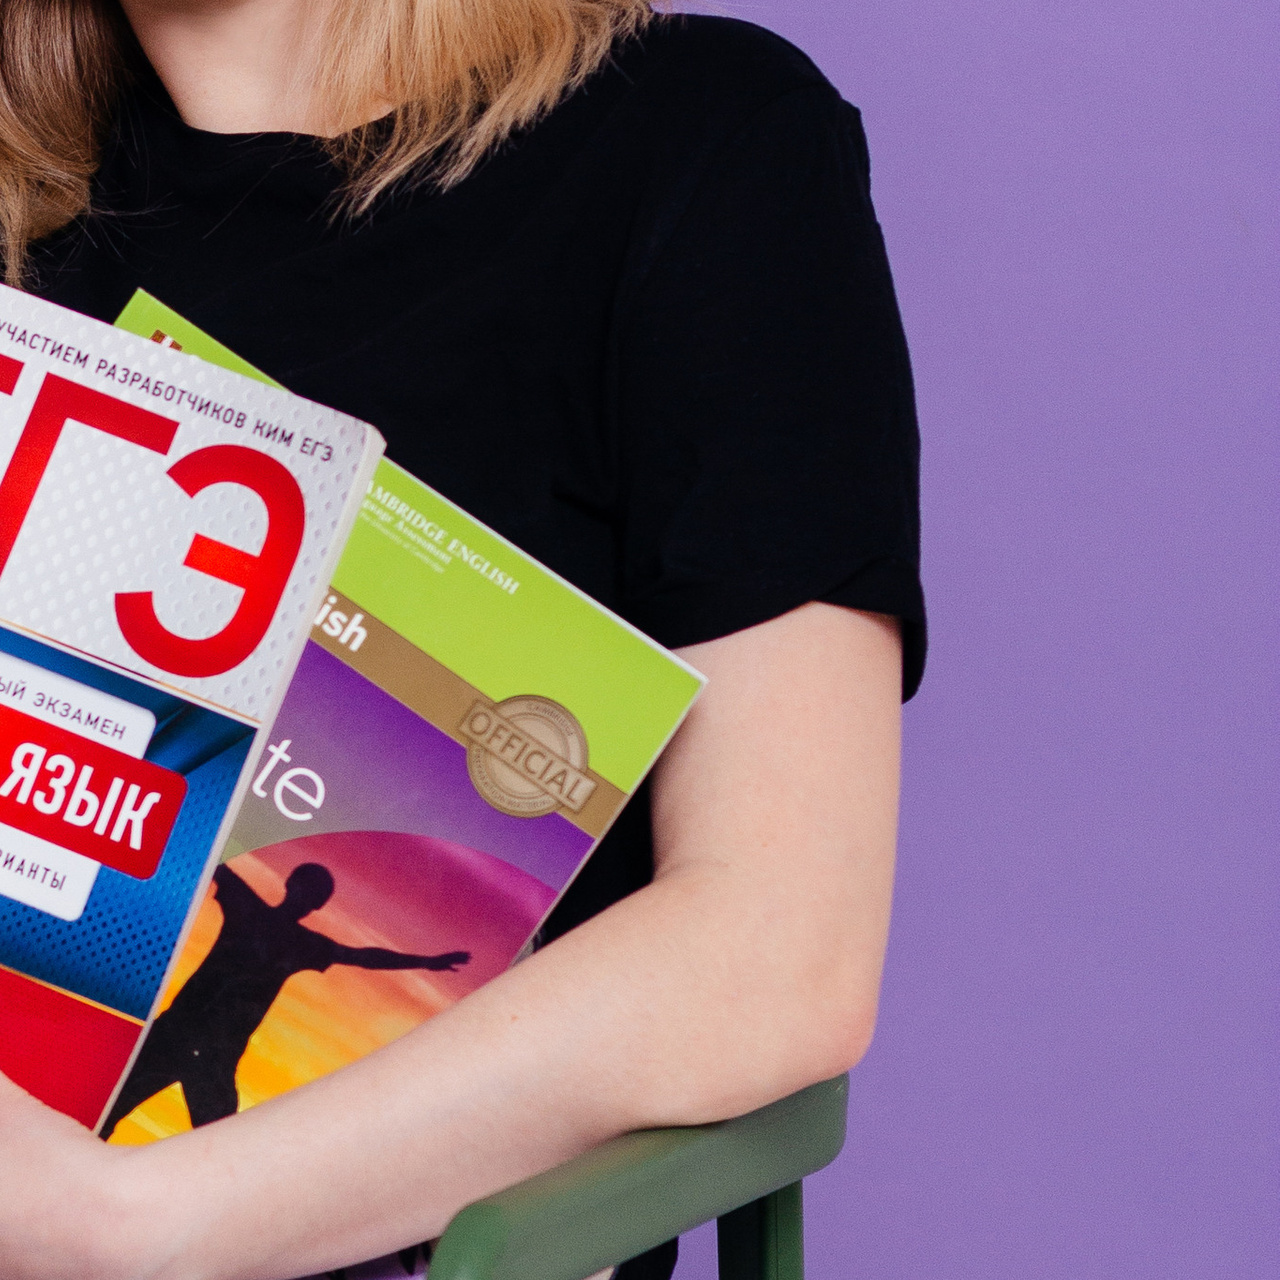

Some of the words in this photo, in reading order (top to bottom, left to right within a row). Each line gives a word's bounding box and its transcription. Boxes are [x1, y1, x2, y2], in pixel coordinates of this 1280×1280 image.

[96, 358, 246, 429] РАЗРАБОТЧИКОВ
[253, 418, 293, 448] КИМ
[300, 436, 334, 462] ЕГЭ
[447, 538, 520, 595] ENGLISH
[32, 690, 126, 741] ЭКЗАМЕН
[469, 712, 579, 803] OFFICIAL
